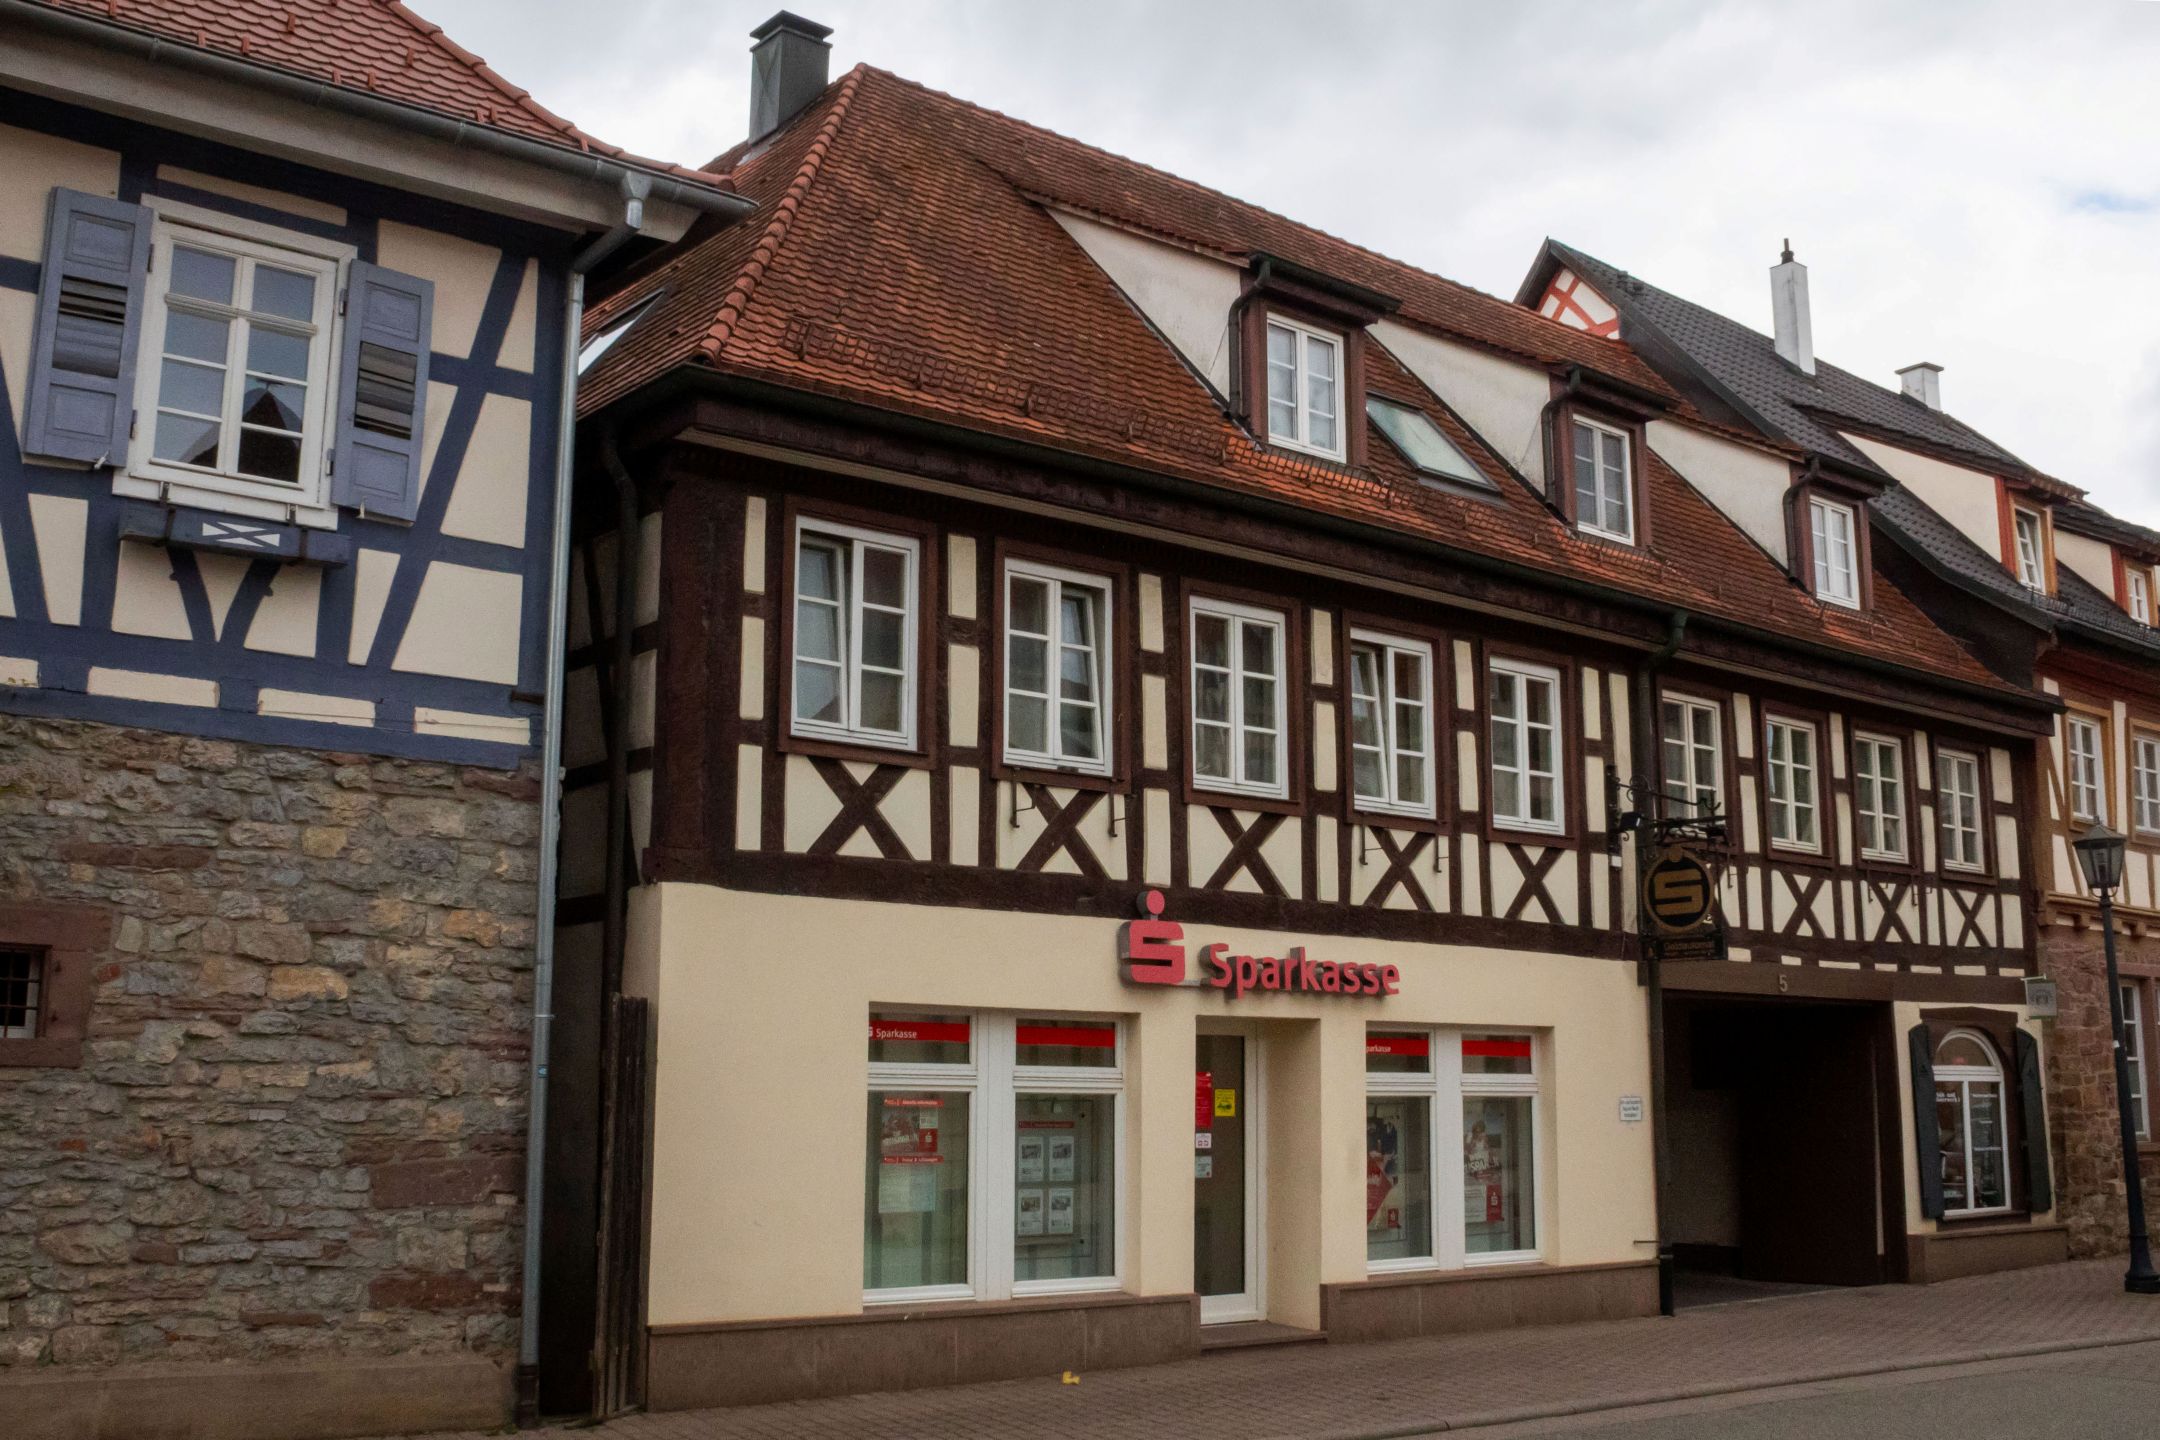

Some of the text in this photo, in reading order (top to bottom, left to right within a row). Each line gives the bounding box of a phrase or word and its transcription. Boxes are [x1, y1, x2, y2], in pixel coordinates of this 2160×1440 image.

[1207, 942, 1400, 1001] Sparkasse
[1779, 974, 1788, 992] 5
[875, 1028, 918, 1039] Sparkasse
[1366, 1044, 1392, 1054] parkasse
